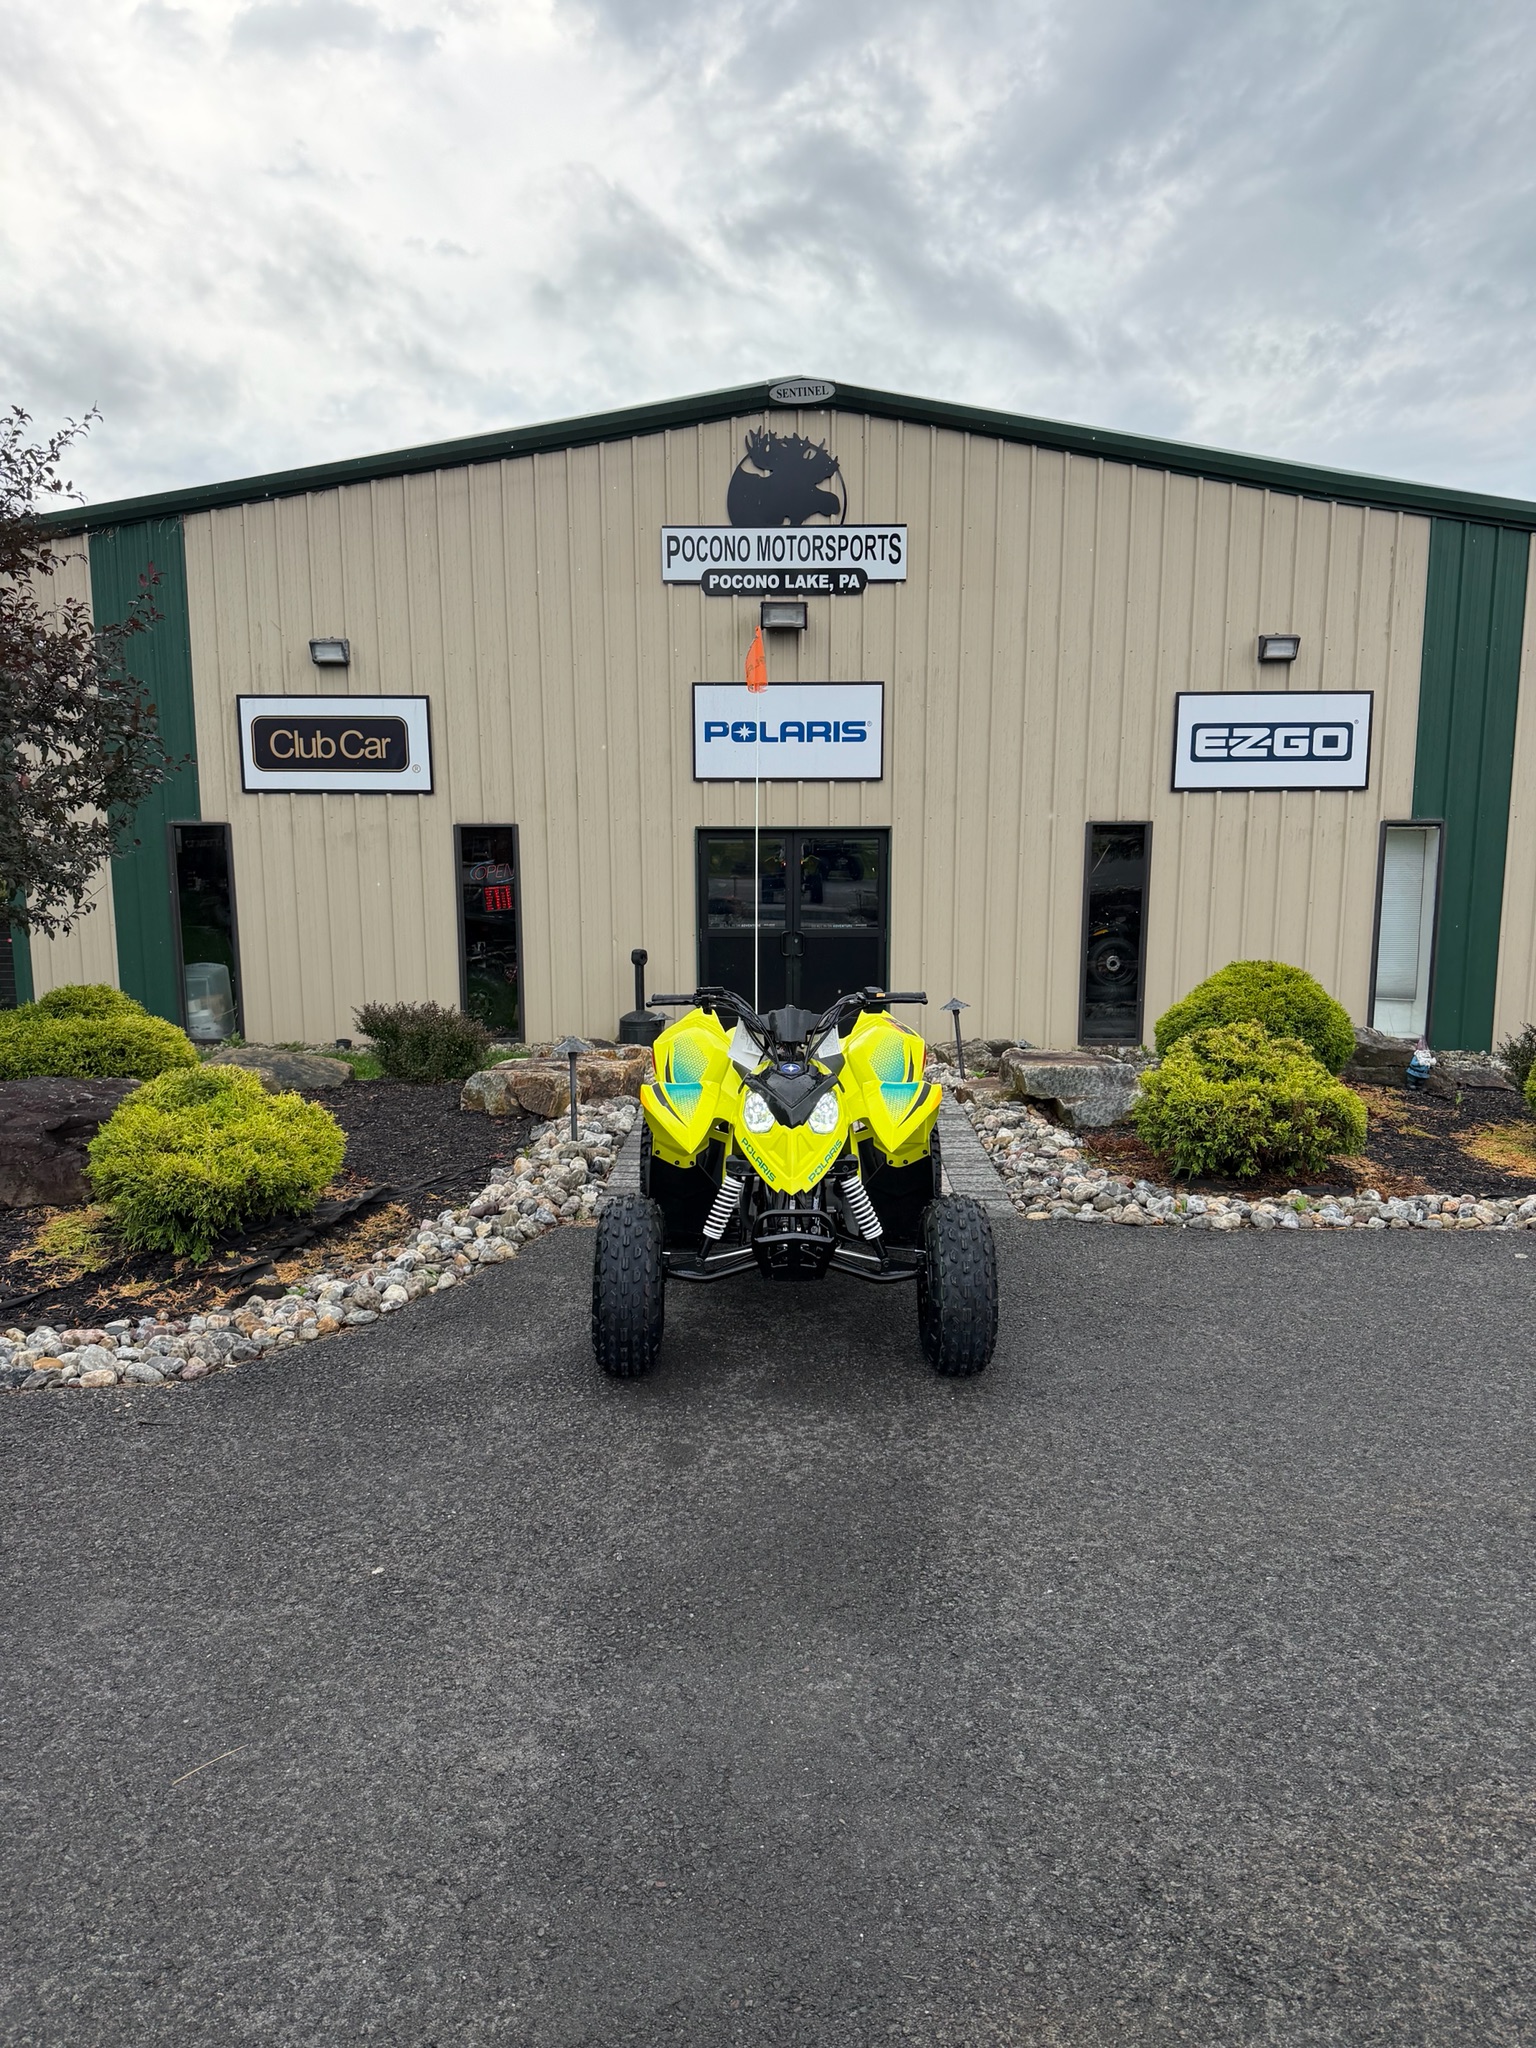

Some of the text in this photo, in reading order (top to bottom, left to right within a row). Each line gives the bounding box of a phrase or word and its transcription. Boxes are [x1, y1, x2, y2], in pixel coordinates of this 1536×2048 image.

[776, 385, 829, 399] SENTINEL
[666, 533, 902, 569] POCONO MOTORSPORTS
[709, 574, 860, 591] POCONO LAKE, PA
[269, 729, 392, 759] Club Car
[704, 721, 867, 743] POLARIS
[1195, 727, 1349, 757] EZGO
[474, 863, 515, 880] OPEN
[741, 1137, 777, 1183] POLARIS
[807, 1138, 843, 1183] POLARIS
